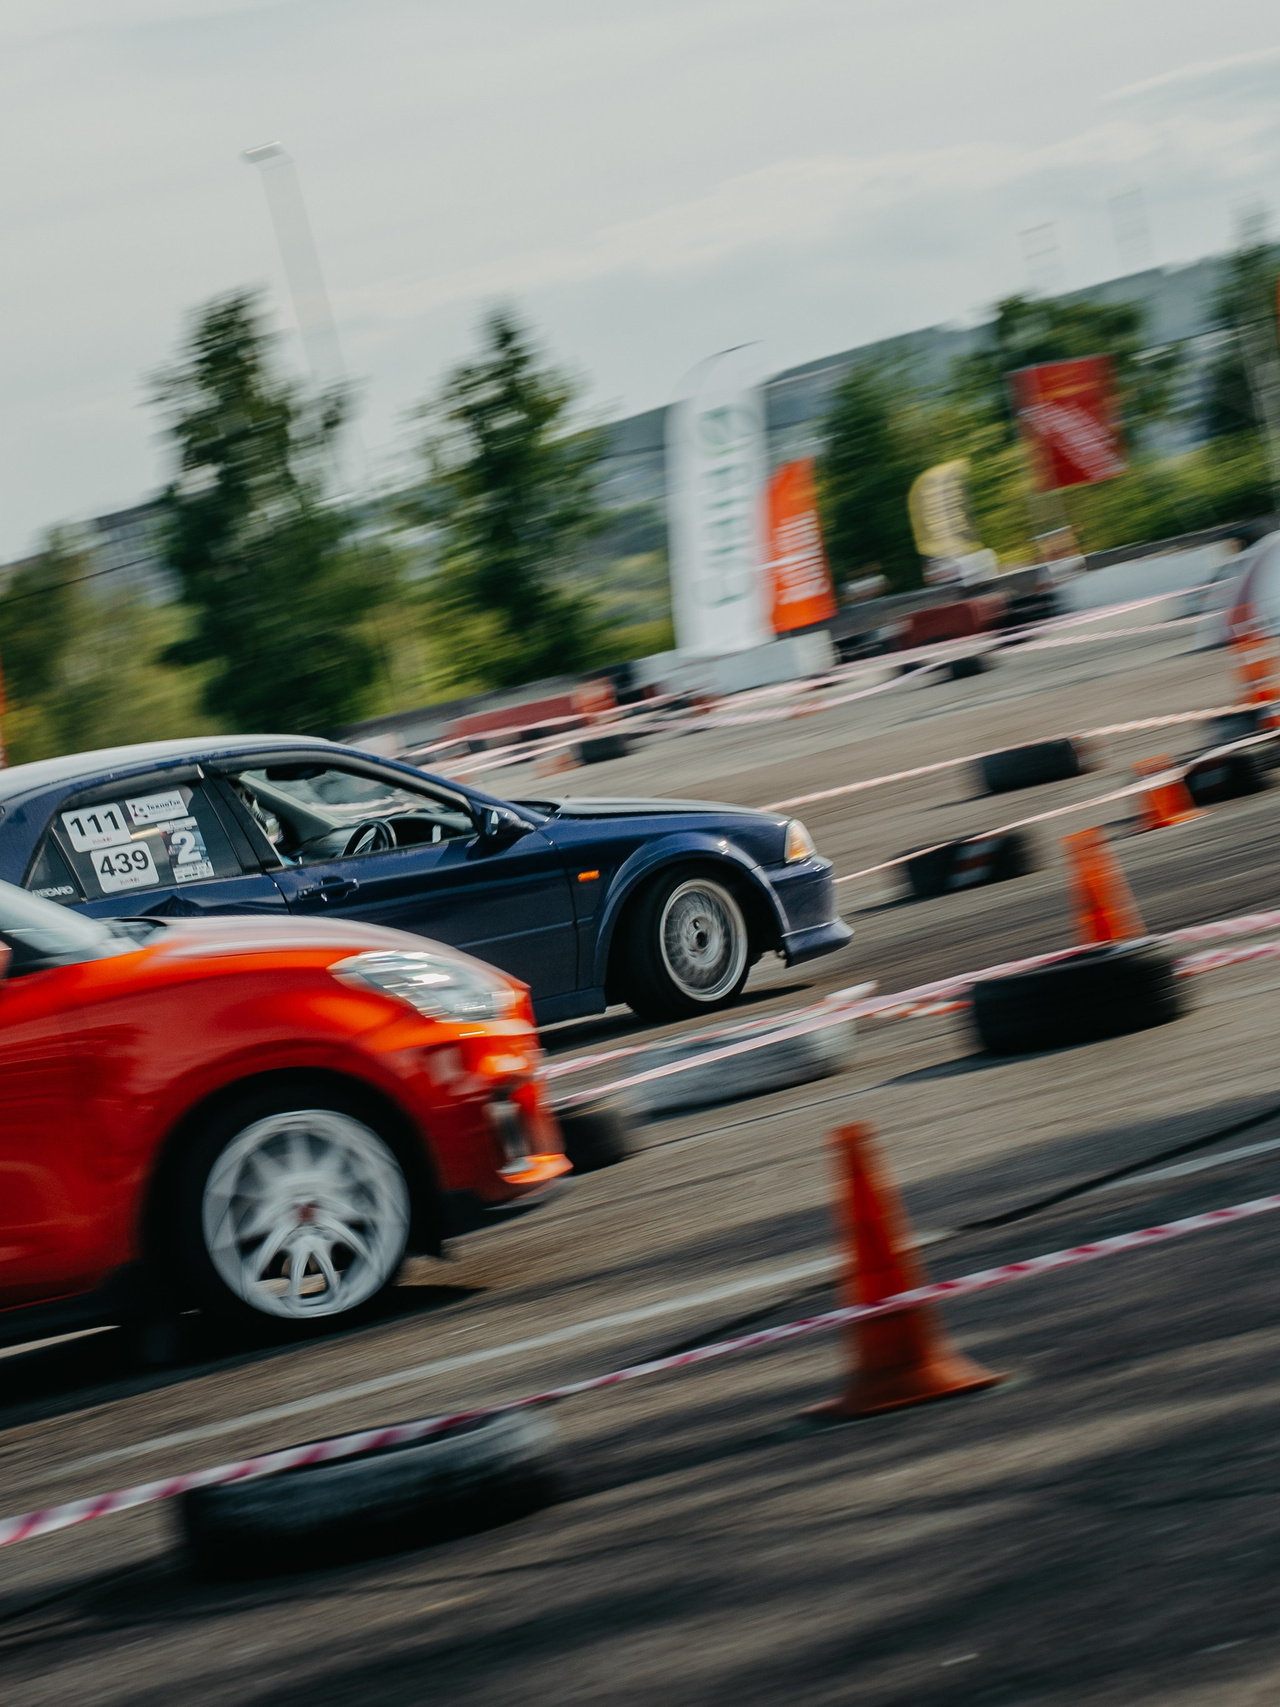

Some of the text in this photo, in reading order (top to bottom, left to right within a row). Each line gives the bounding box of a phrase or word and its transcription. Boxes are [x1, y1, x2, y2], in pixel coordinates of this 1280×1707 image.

[70, 810, 120, 837] 111
[171, 830, 203, 865] 2
[101, 849, 149, 876] 439
